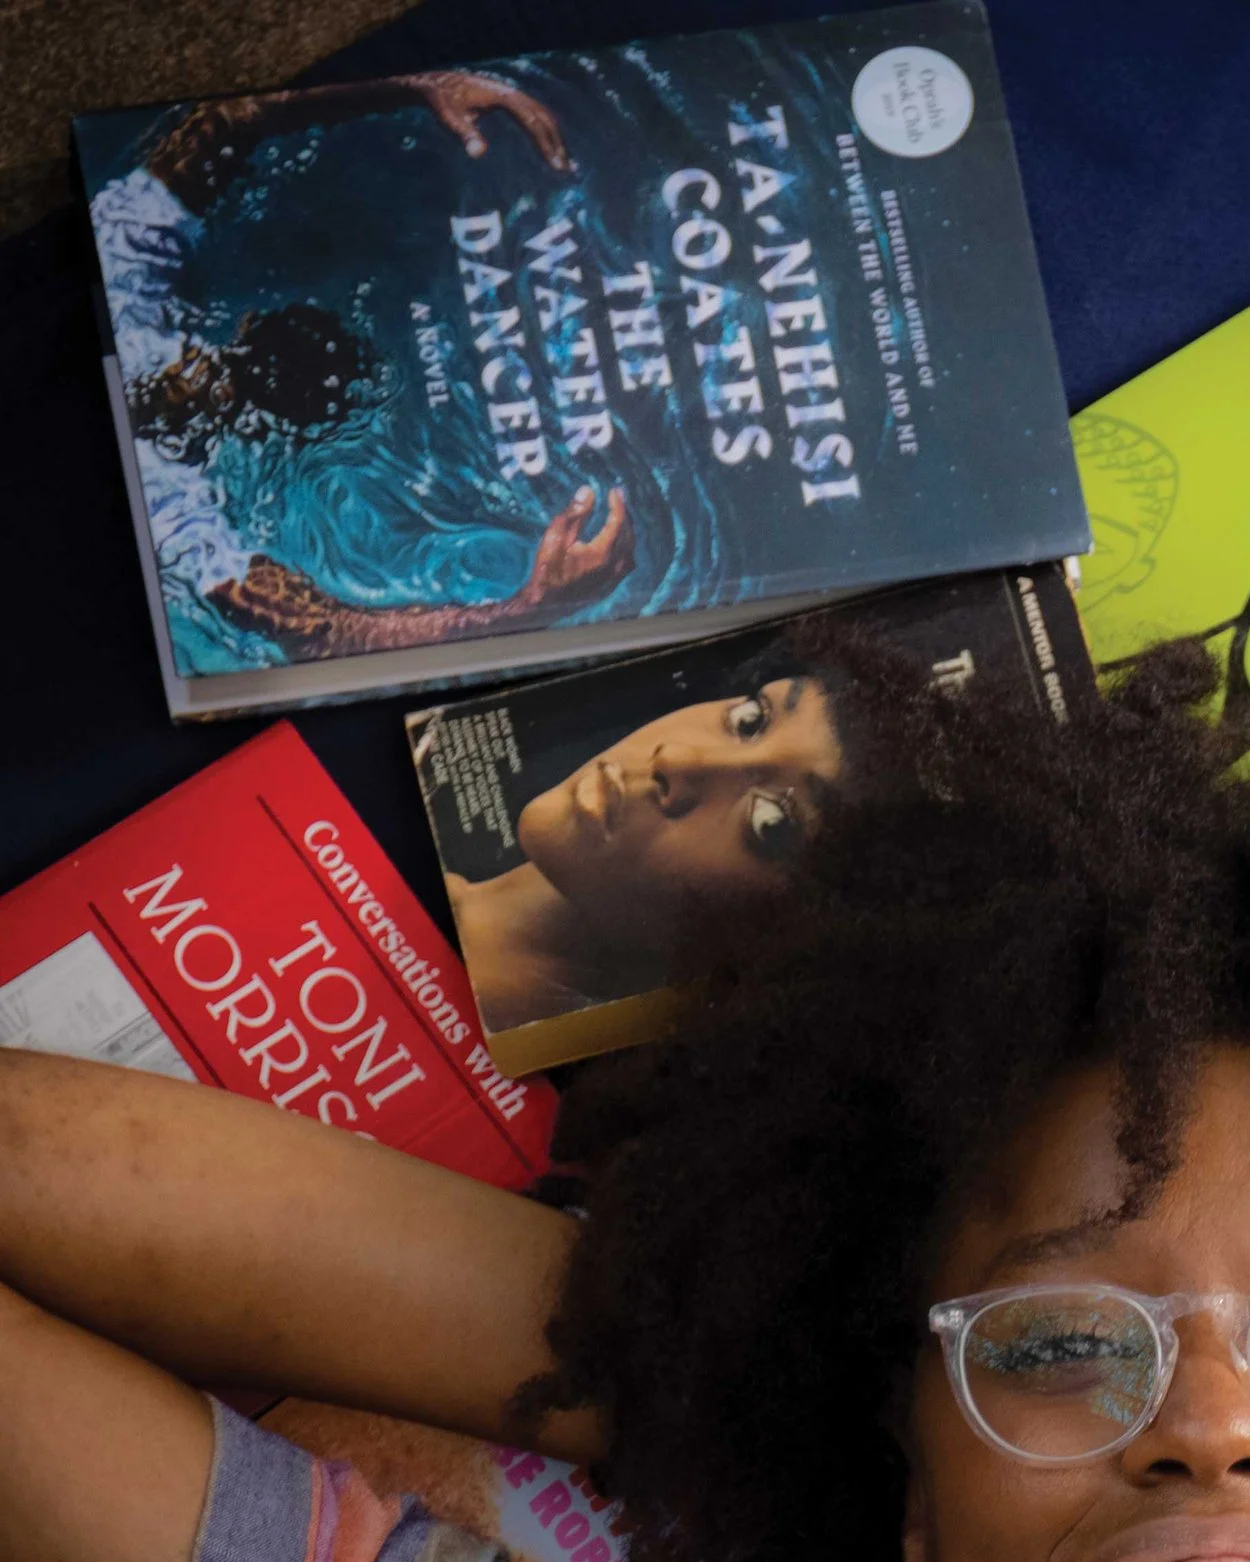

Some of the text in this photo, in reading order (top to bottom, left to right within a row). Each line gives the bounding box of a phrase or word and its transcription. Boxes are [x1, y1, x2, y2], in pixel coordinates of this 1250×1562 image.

[901, 104, 925, 144] Club
[409, 301, 449, 408] A NOVEL
[450, 209, 548, 481] DANCER
[524, 217, 614, 456] WATER
[603, 260, 673, 391] THE
[662, 167, 773, 465] COATES
[728, 103, 861, 507] TA-NEHISI
[836, 133, 918, 456] BETWEEN THE WORLD AND ME
[881, 189, 935, 388] BESTSELLING AUTHOR OF
[1016, 576, 1034, 594] A
[1022, 592, 1056, 672] MENTOR
[268, 920, 426, 1111] TONI
[303, 820, 529, 1121] Conversations with
